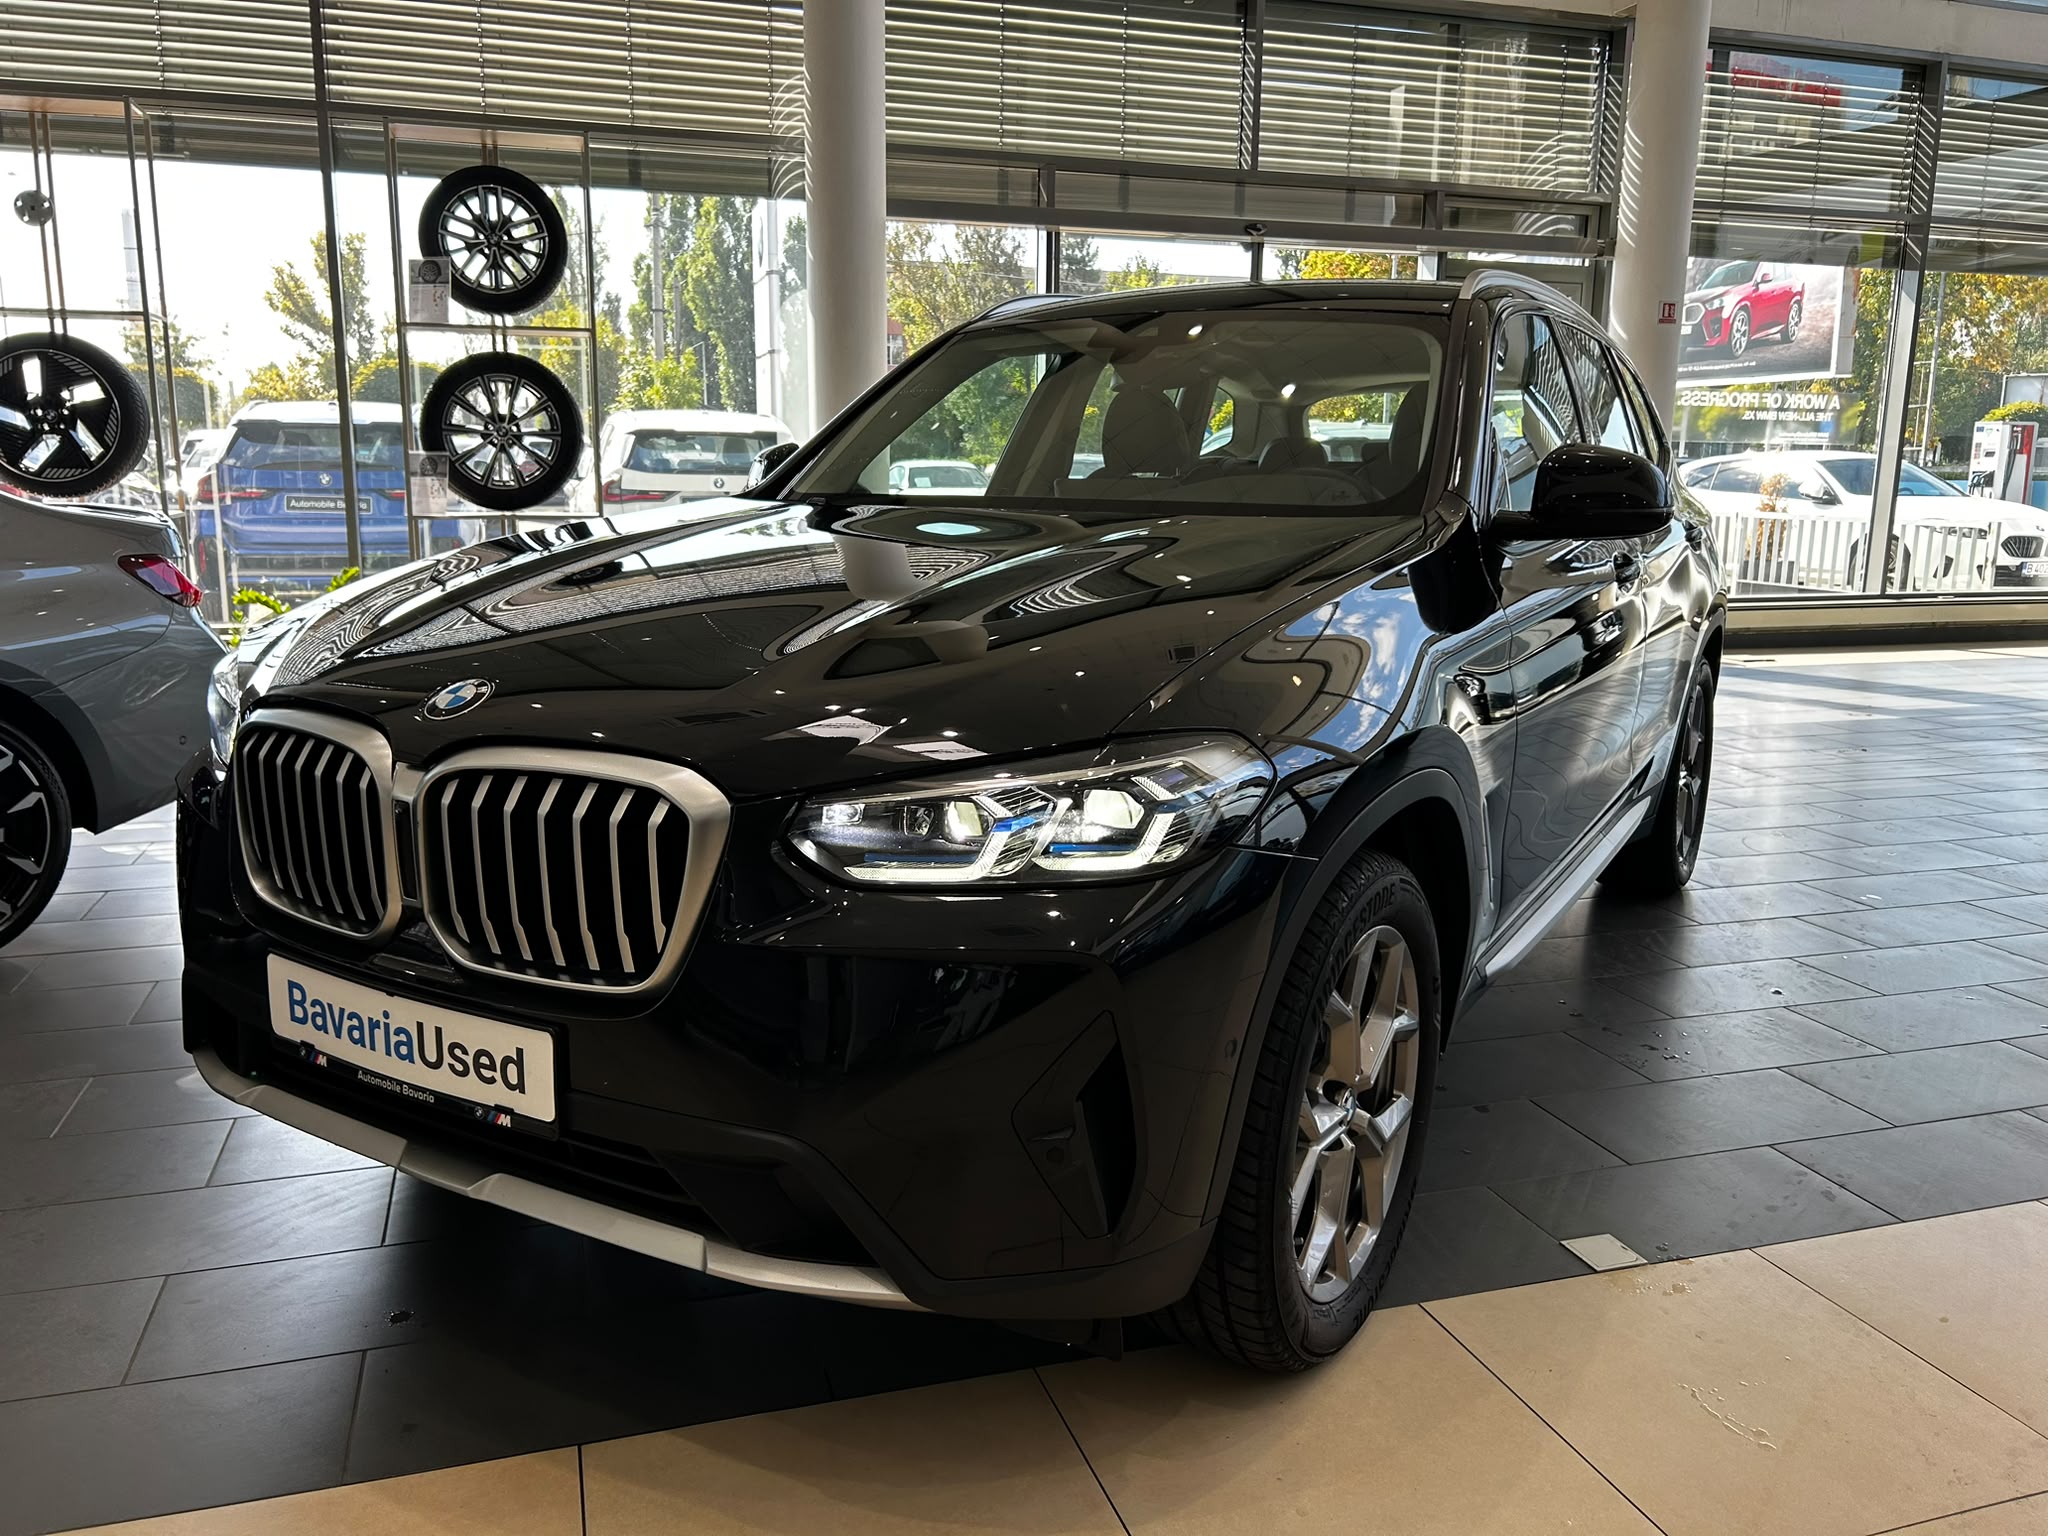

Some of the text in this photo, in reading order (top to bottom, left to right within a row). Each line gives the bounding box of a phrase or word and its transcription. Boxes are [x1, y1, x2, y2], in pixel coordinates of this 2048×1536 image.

[289, 498, 335, 508] Automobile
[287, 979, 527, 1095] BavariaUsed
[357, 1070, 434, 1103] Automobile Bavaria
